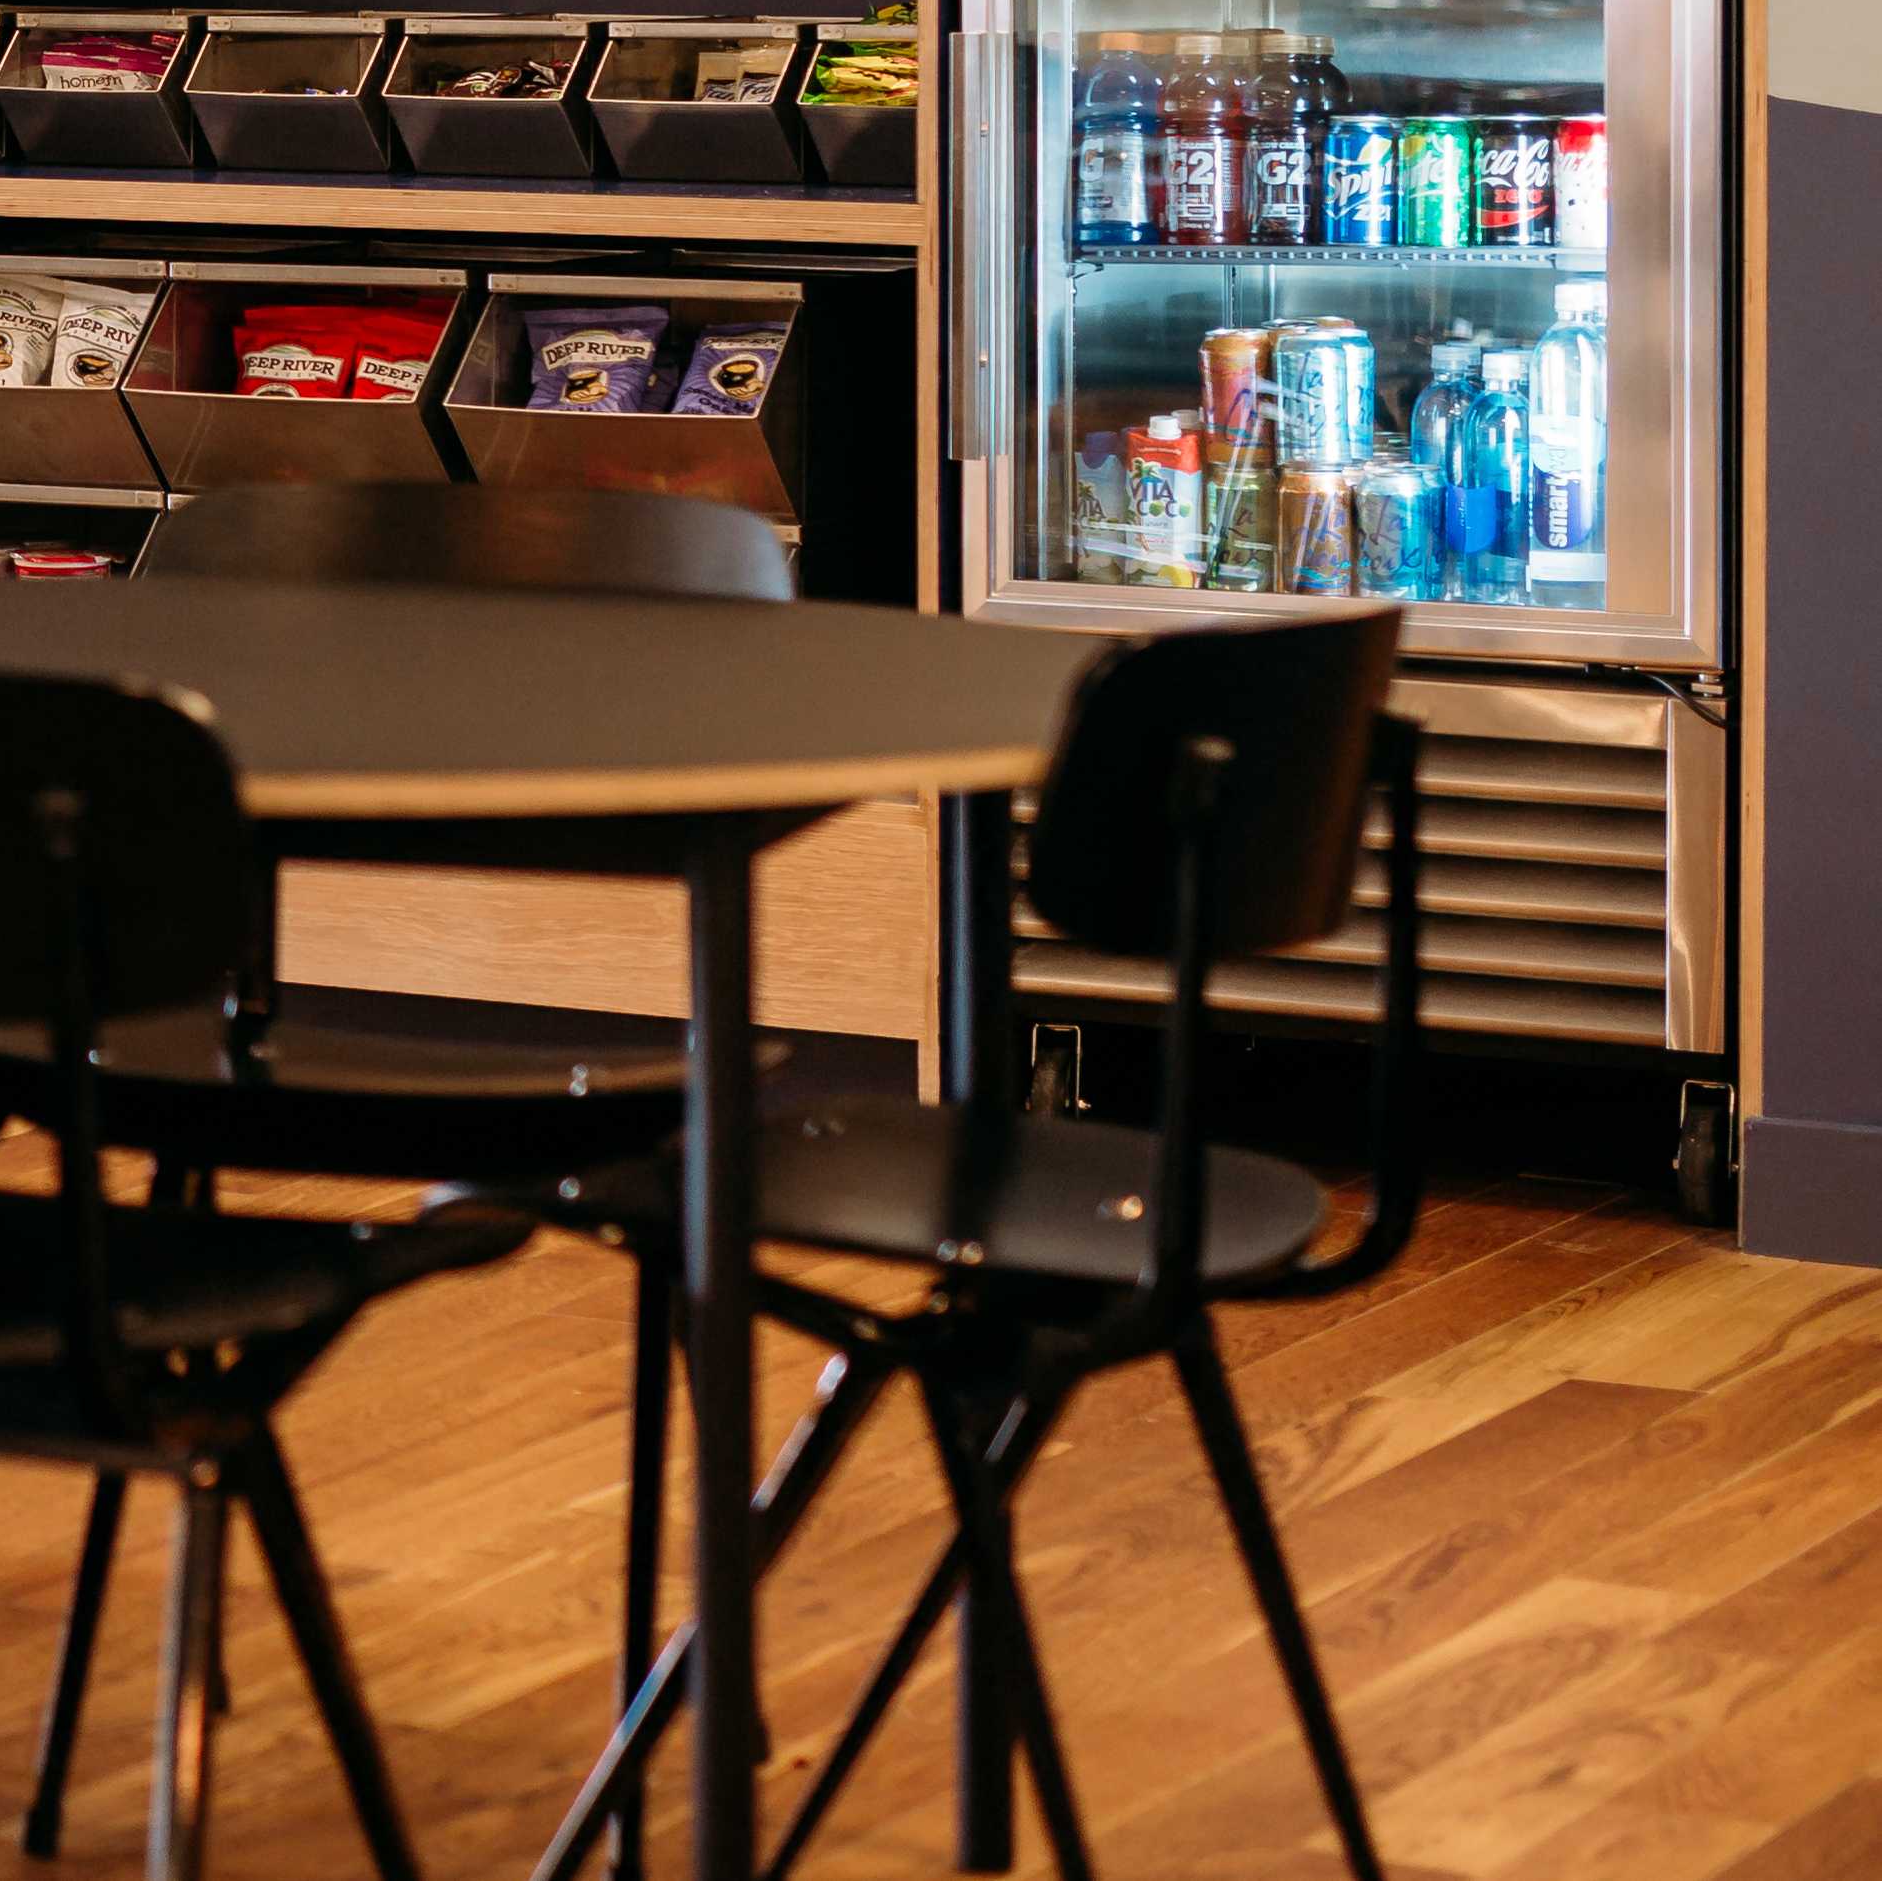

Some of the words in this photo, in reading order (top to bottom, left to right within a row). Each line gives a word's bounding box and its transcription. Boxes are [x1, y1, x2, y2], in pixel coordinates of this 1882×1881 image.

[1080, 138, 1104, 183] G
[1166, 150, 1214, 185] G2
[1258, 151, 1312, 185] G2
[0, 311, 53, 336] RIVER
[62, 318, 103, 333] DEEP
[546, 342, 585, 365] DEEP
[586, 341, 646, 357] RIVER
[247, 356, 281, 370] EEP
[283, 357, 335, 376] RIVER
[363, 361, 411, 383] DEEP
[1132, 478, 1174, 500] VITA
[1137, 499, 1192, 518] COCO
